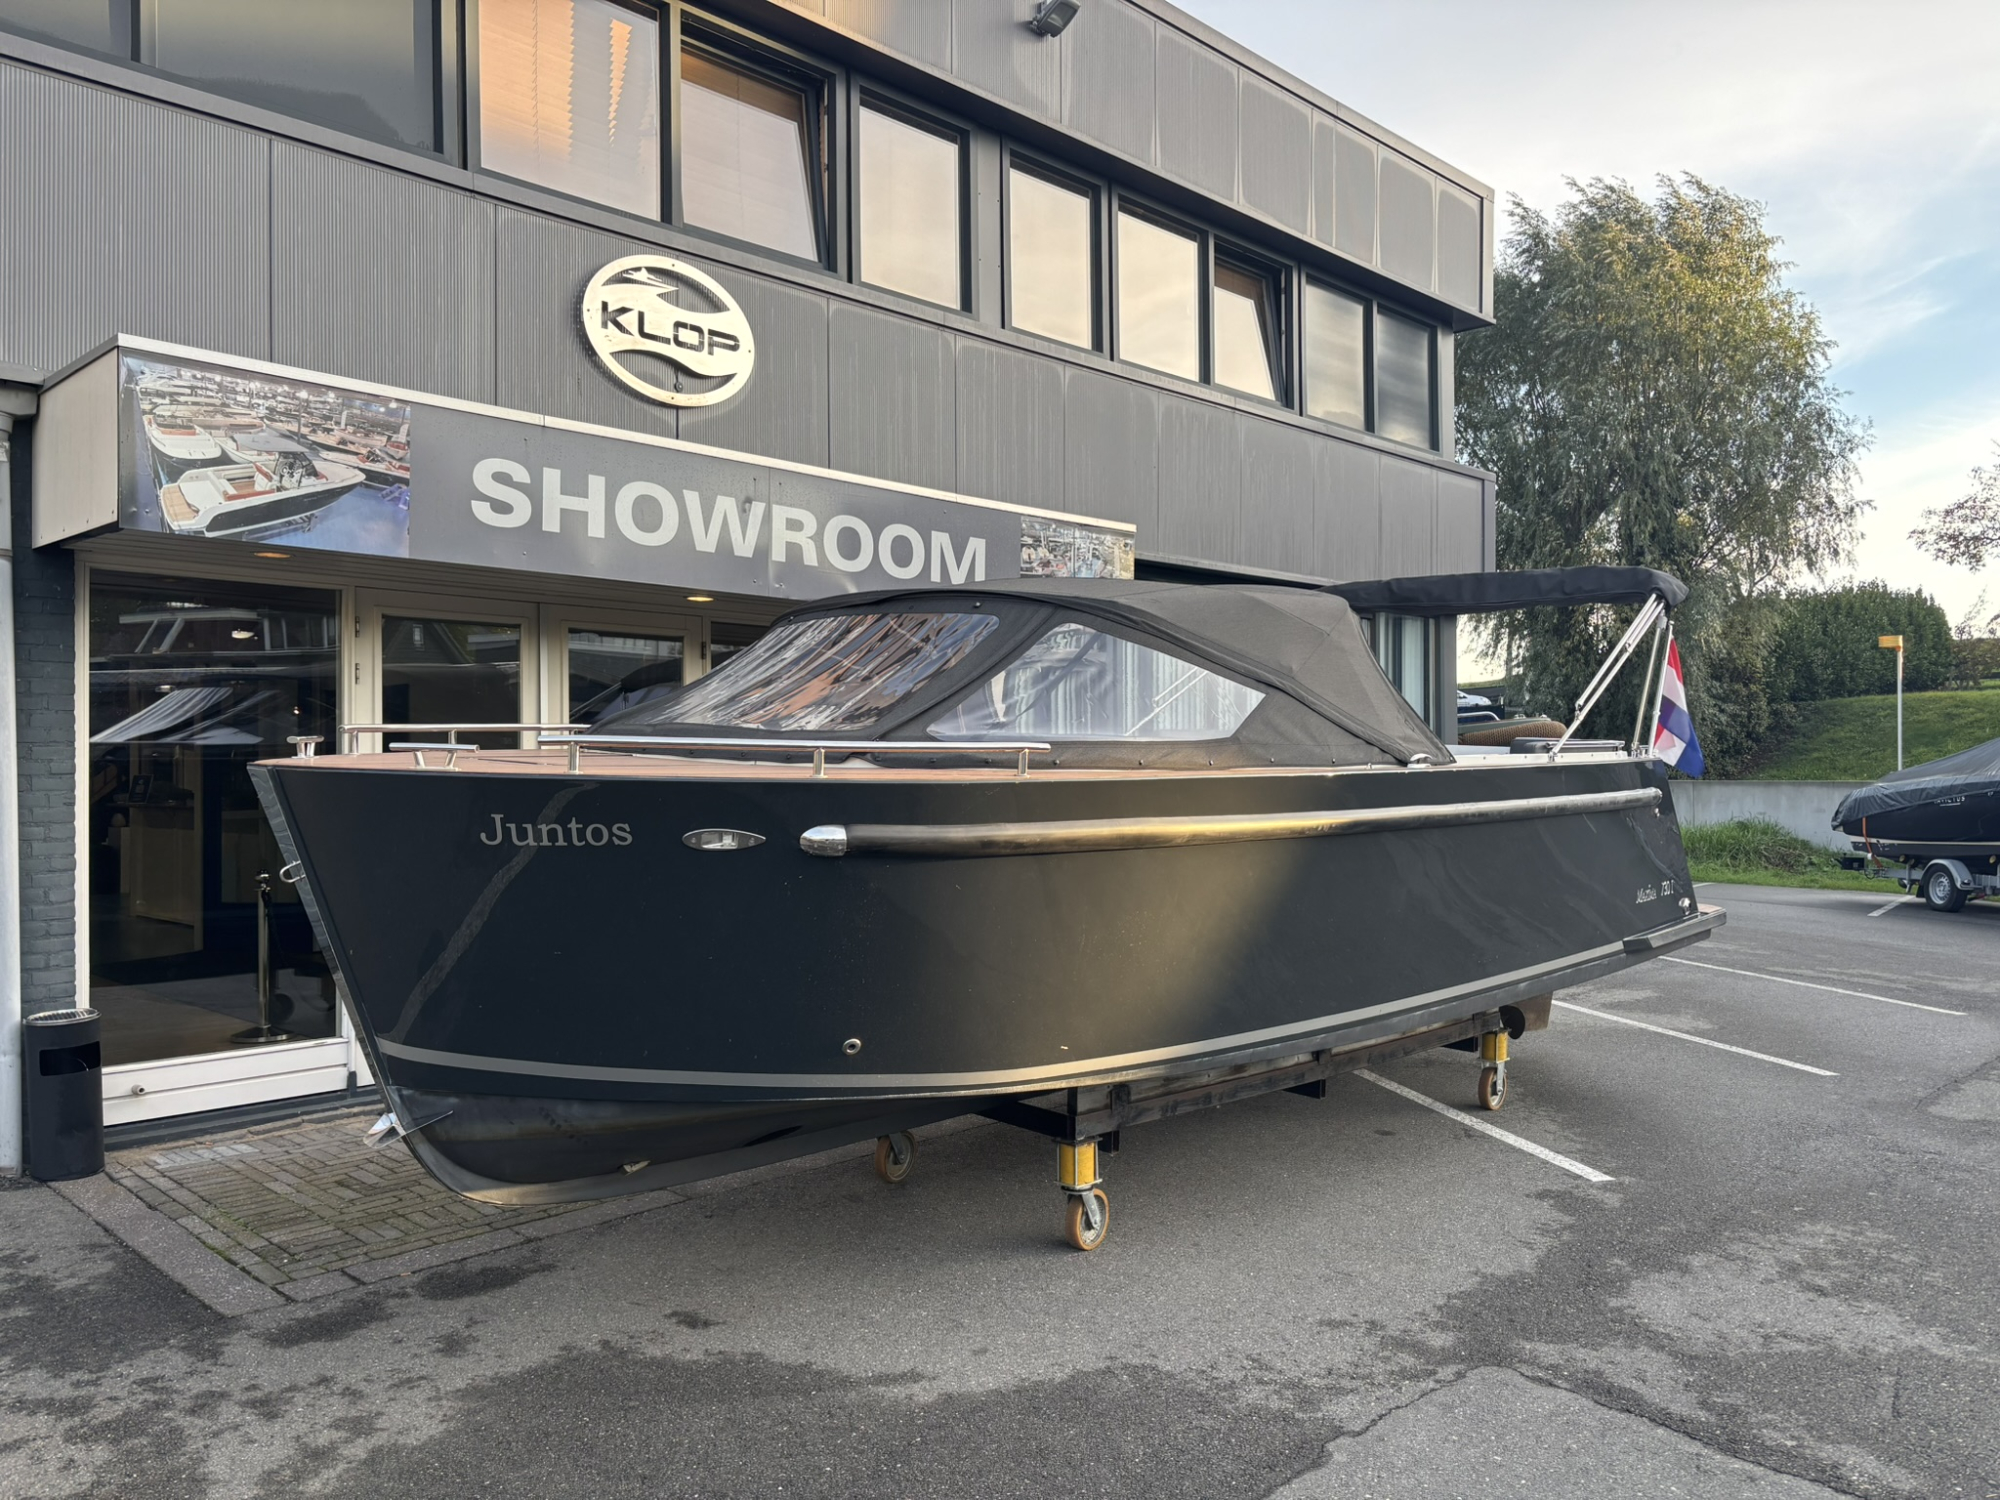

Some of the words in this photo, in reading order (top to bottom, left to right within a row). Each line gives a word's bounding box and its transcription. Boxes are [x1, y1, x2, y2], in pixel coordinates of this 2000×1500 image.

[601, 300, 741, 356] KLOP
[471, 458, 986, 585] SHOWROOM
[480, 813, 633, 847] Juntos
